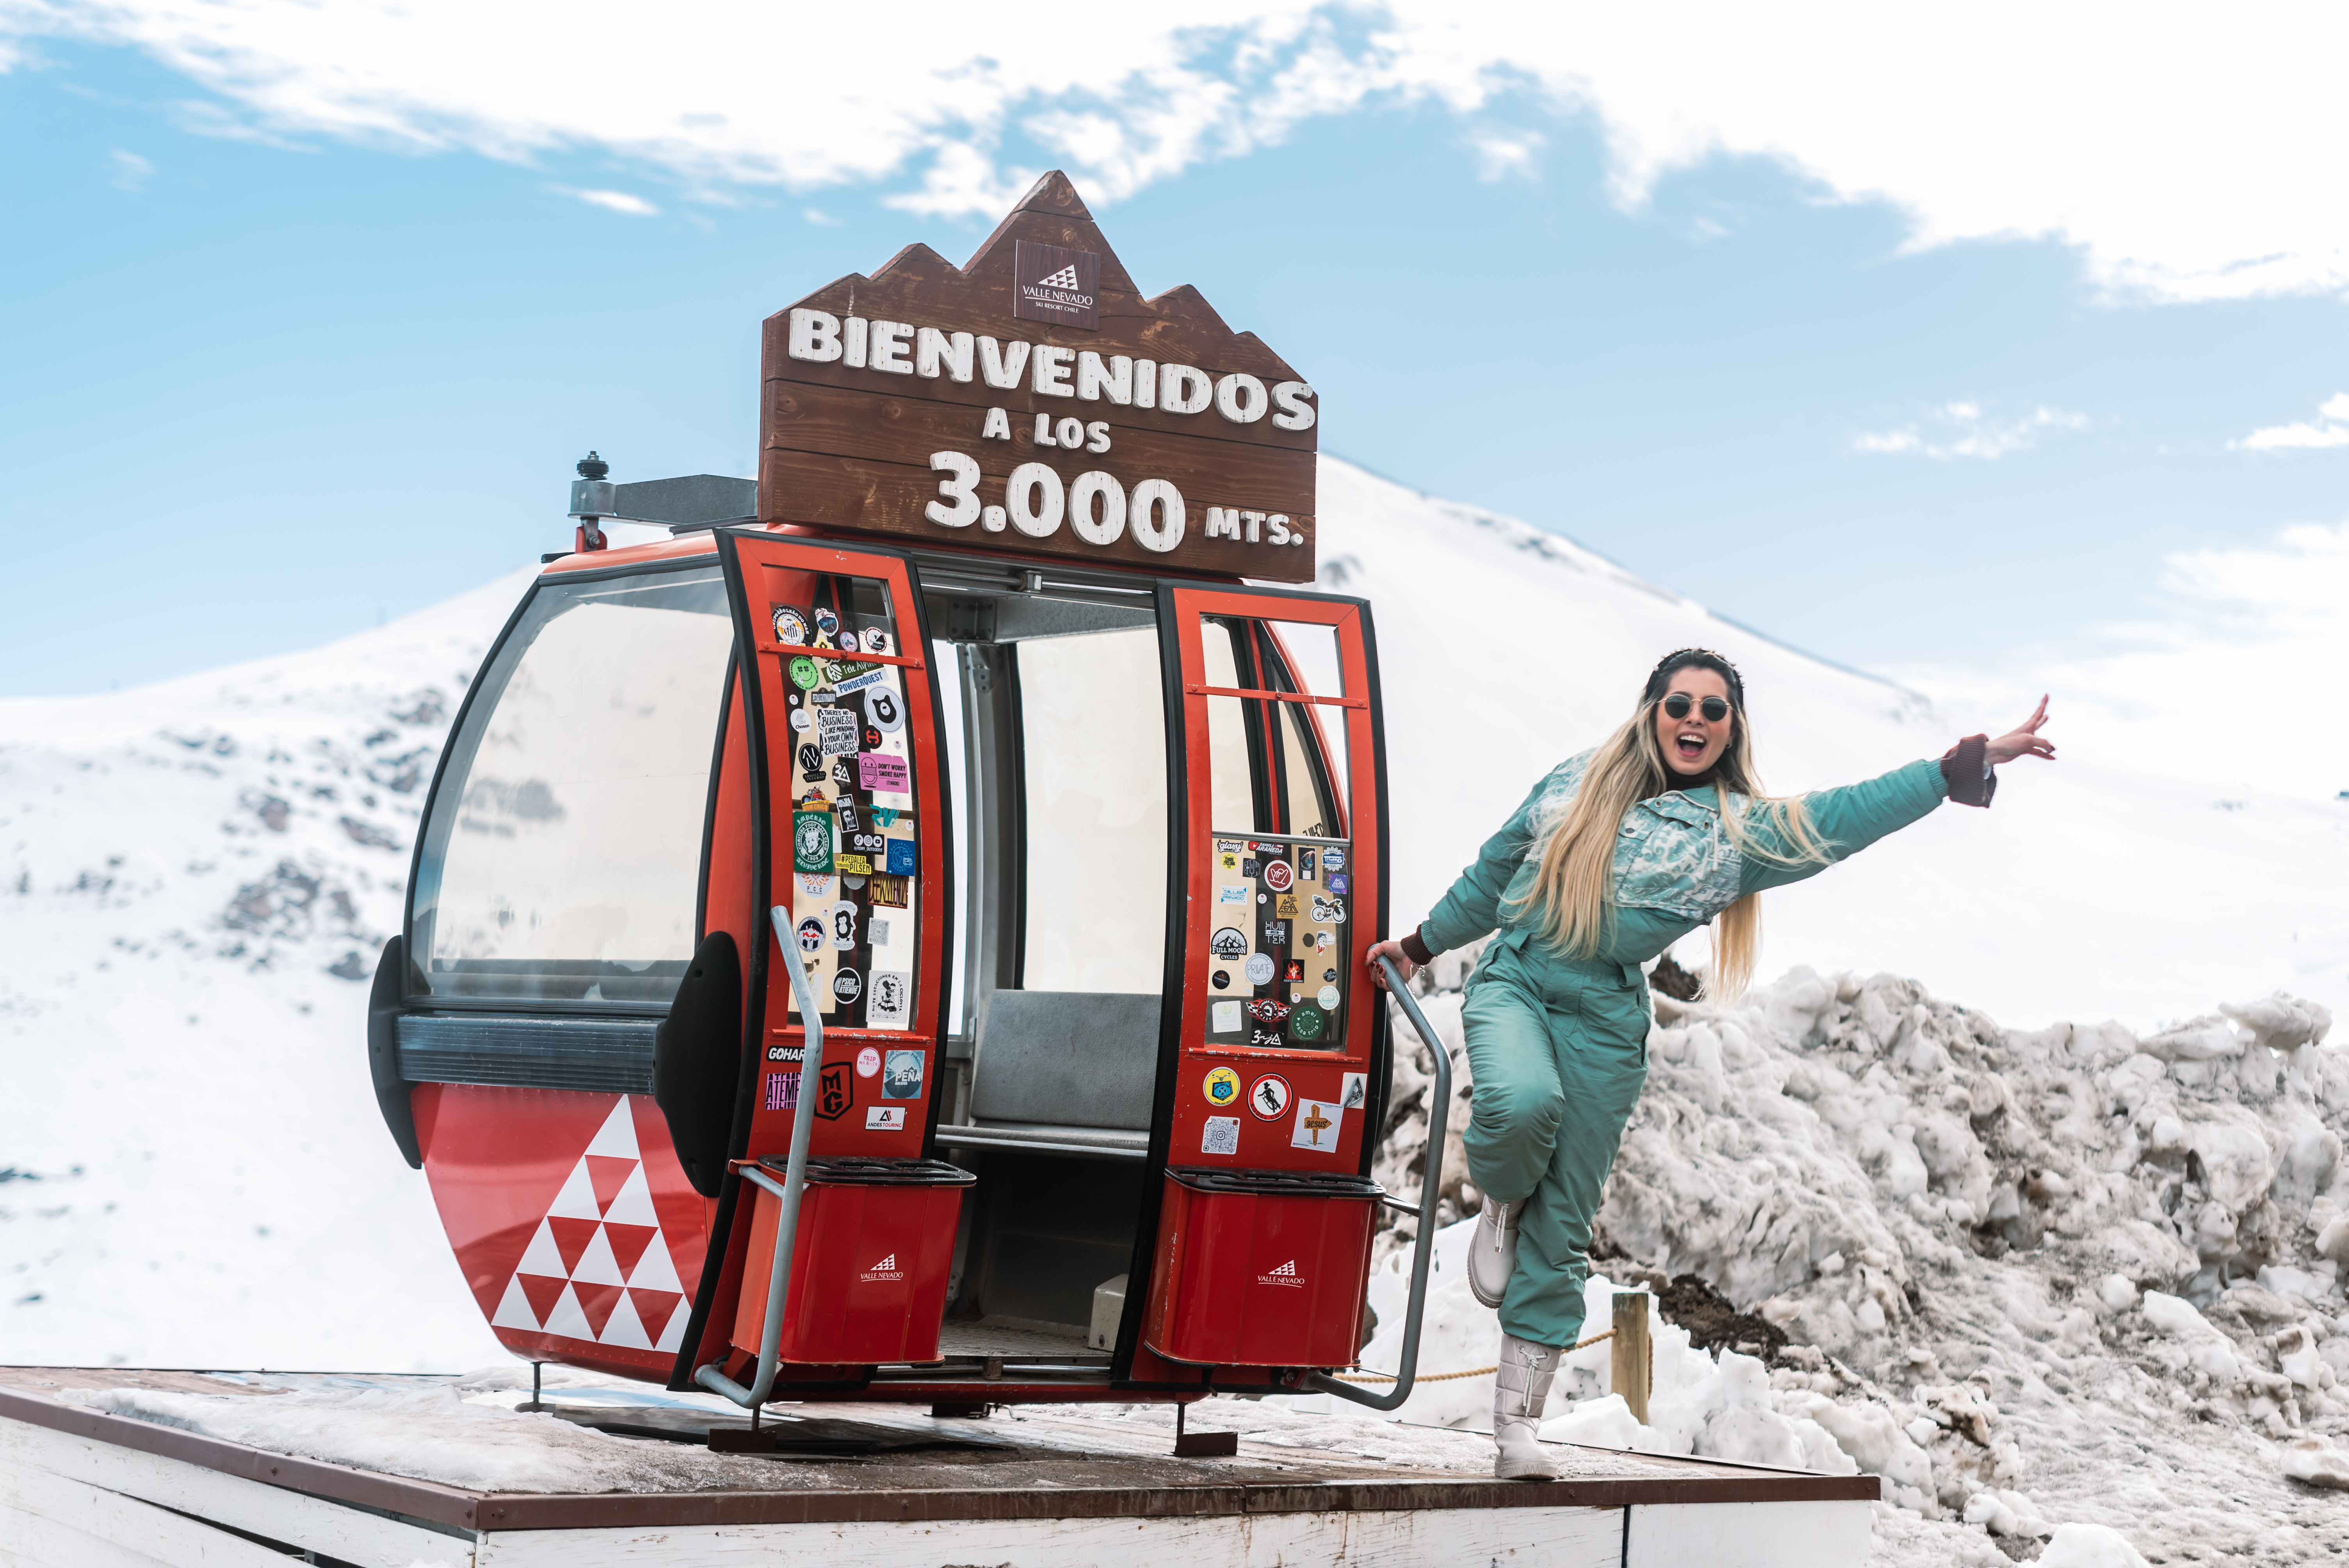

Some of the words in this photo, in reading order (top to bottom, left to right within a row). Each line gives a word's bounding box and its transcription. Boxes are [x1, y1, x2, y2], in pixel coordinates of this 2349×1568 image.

[1023, 285, 1050, 298] VALLE
[1053, 290, 1093, 305] NEVADO
[789, 308, 1316, 431] BIENVENIDOS
[982, 407, 1011, 440] A
[1034, 413, 1110, 454] LOS
[924, 451, 1185, 552] 3.000
[1205, 506, 1304, 547] MTS.
[842, 665, 856, 674] Tele
[805, 675, 818, 690] MOMENTO
[838, 672, 883, 693] POWDERQUEST
[821, 716, 853, 727] BUSINESS
[827, 734, 840, 744] YOUR
[841, 732, 854, 742] OWN
[797, 813, 826, 825] IMPÉRIO
[841, 855, 865, 865] #PEDALEA
[850, 863, 870, 873] PILSEN
[1265, 921, 1285, 930] HUN
[1265, 935, 1285, 944] TER
[1247, 963, 1271, 975] PRIVATE
[873, 974, 891, 996] ESTACIONES
[1260, 1000, 1270, 1009] KINDER
[1296, 1023, 1306, 1035] essa
[1308, 1025, 1319, 1035] trip
[888, 1052, 909, 1065] Peñabikers
[896, 1070, 921, 1082] PEÑA
[1270, 1075, 1287, 1086] UTAH
[1250, 1103, 1267, 1119] RODEL
[1307, 1120, 1328, 1128] JESUS
